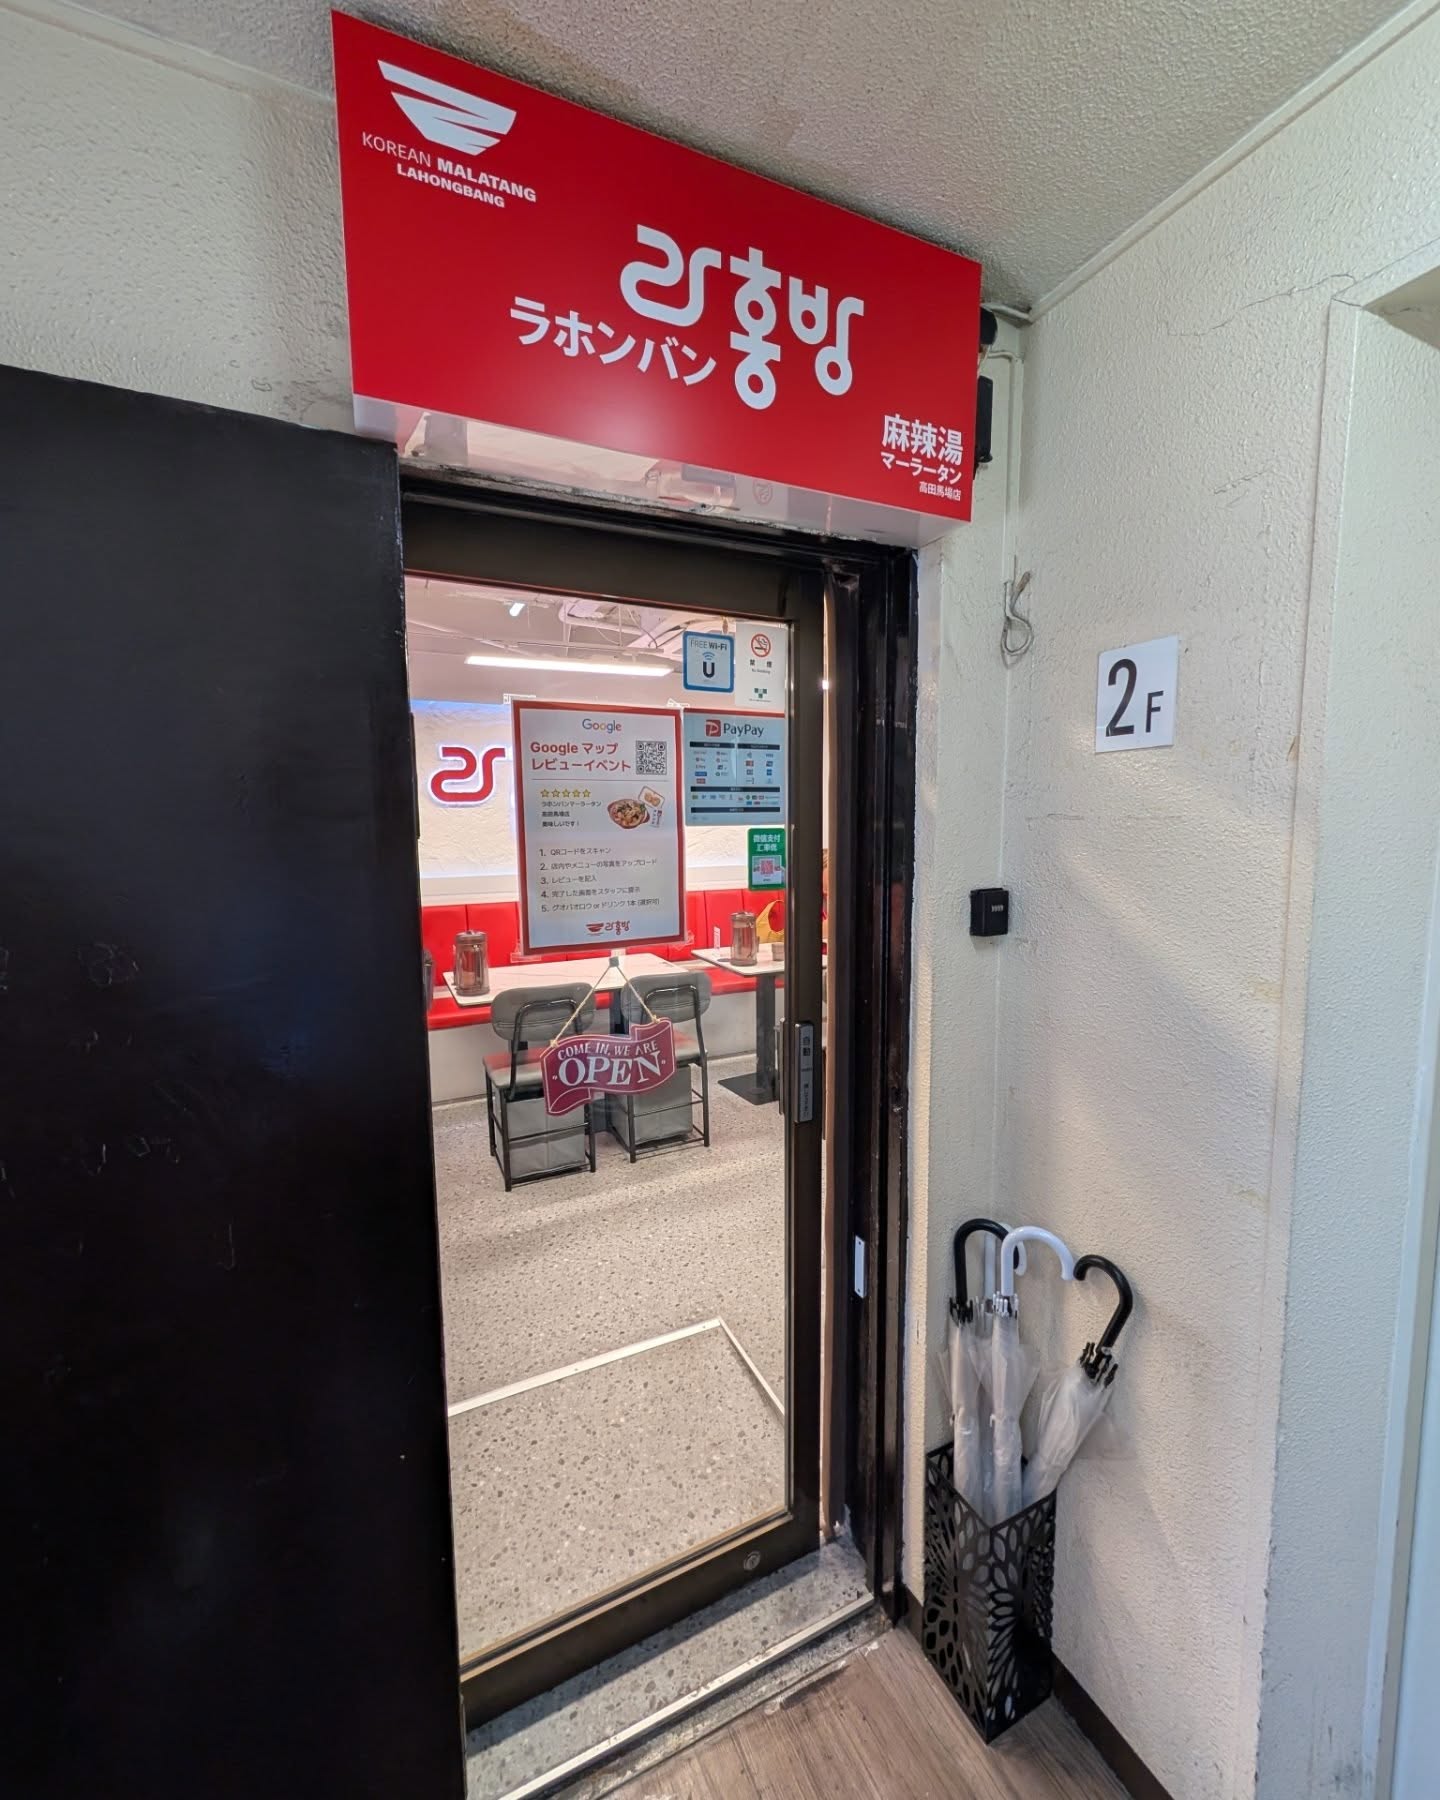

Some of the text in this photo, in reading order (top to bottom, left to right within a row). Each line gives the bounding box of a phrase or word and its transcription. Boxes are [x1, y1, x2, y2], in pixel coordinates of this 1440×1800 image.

[362, 131, 537, 203] KOREAN MALATANG
[396, 163, 505, 208] LAHONGBANG
[619, 223, 864, 410] 라홍방
[510, 296, 717, 386] ラホンバン
[881, 413, 963, 465] 麻辣湯
[880, 451, 962, 485] マーラータン
[919, 481, 961, 501] 高田馬場店
[690, 639, 708, 649] FREE
[582, 718, 622, 734] Google
[723, 722, 765, 738] PayPay
[530, 741, 619, 756] Google マップ
[531, 758, 632, 772] レビューイベント
[539, 847, 612, 857] 1. QRコードをスキャン
[540, 862, 548, 871] 2.
[540, 875, 598, 885] 3. レビューを記入
[540, 890, 549, 899] 4.
[541, 904, 550, 913] 5.
[557, 1042, 592, 1060] COME
[614, 1045, 630, 1056] WE
[635, 1040, 658, 1056] ARE
[558, 1050, 661, 1087] OPEN
